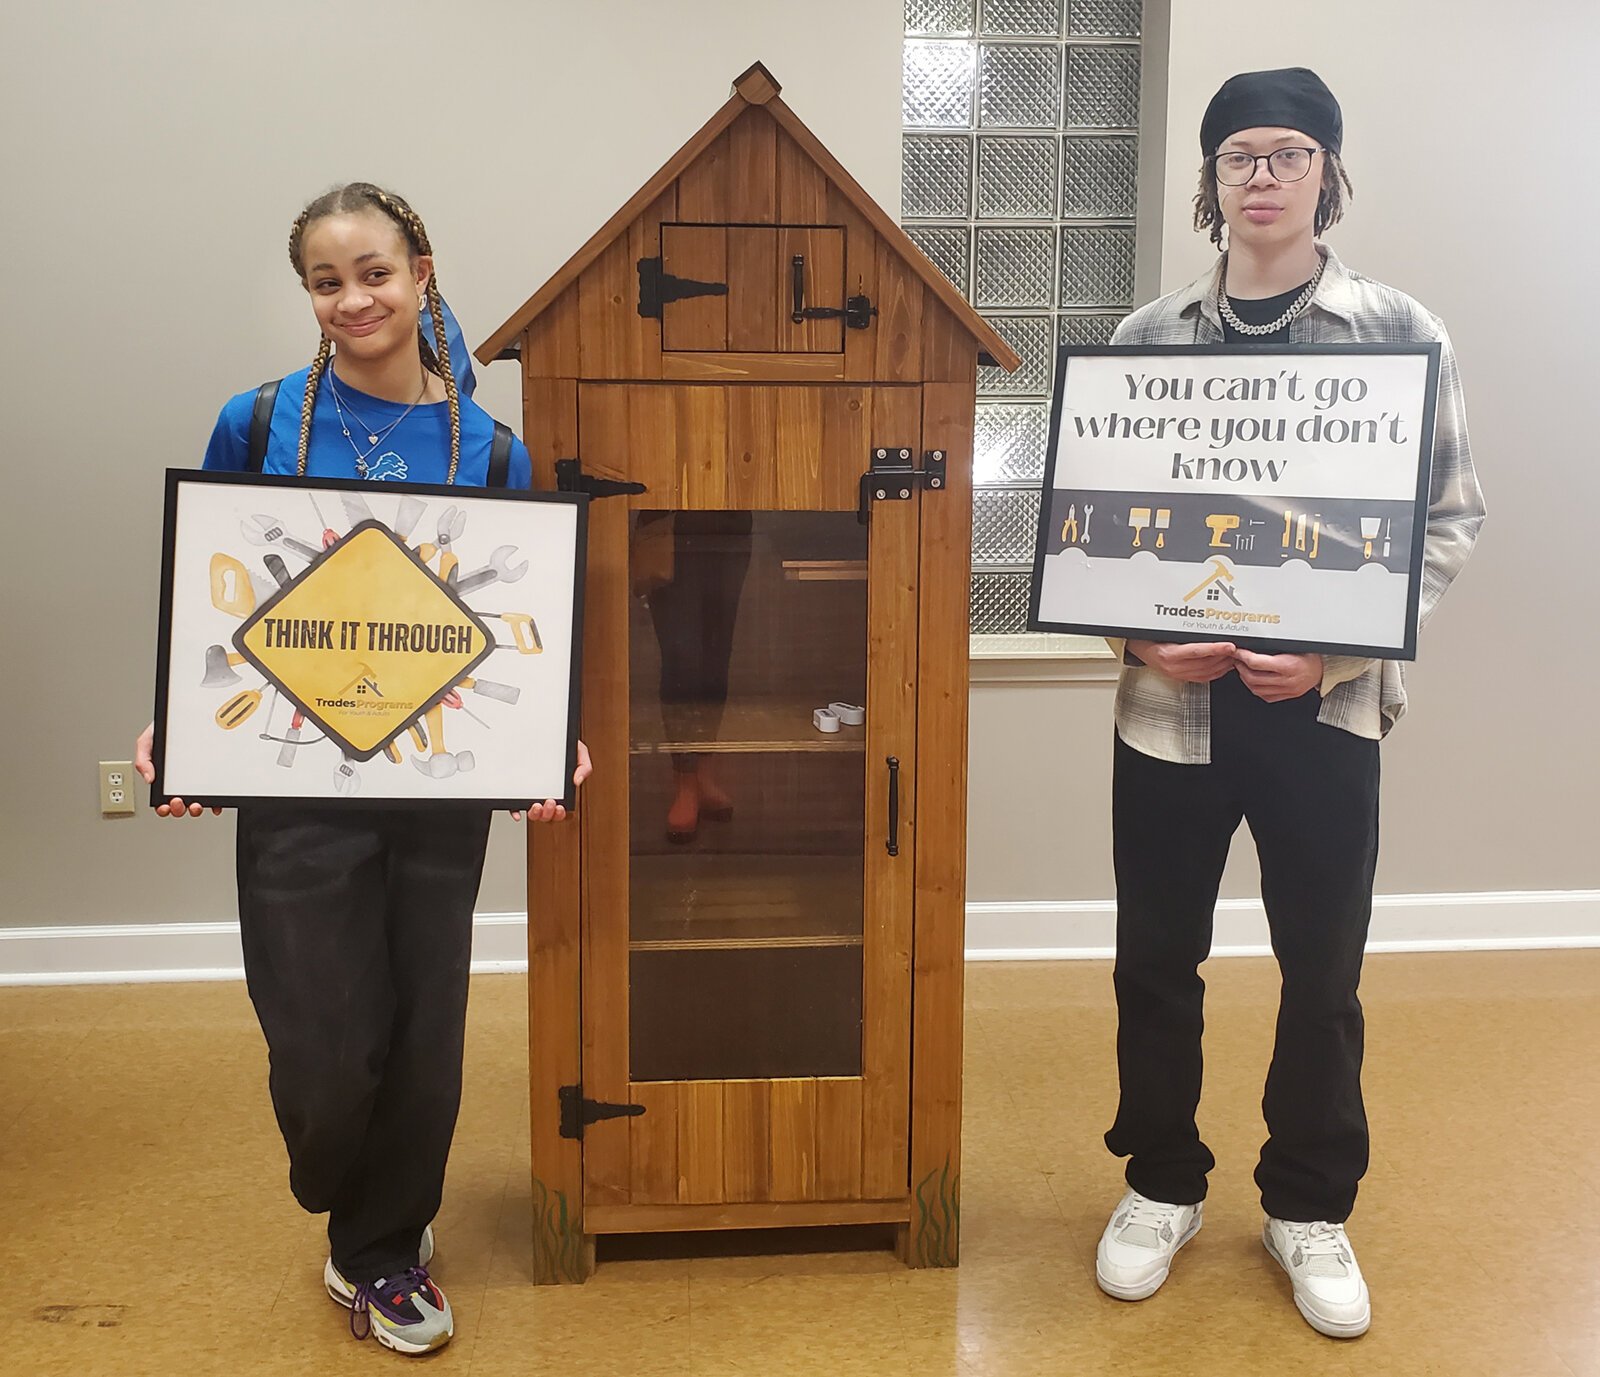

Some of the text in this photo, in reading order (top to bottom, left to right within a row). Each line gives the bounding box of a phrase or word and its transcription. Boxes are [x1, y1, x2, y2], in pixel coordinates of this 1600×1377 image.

[1125, 370, 1368, 410] You can't go
[1074, 412, 1408, 449] where you don't
[1171, 453, 1287, 482] know
[264, 618, 473, 654] THINK IT THROUGH
[1182, 620, 1194, 628] For
[1196, 621, 1217, 630] Youth
[1225, 623, 1249, 632] Adults
